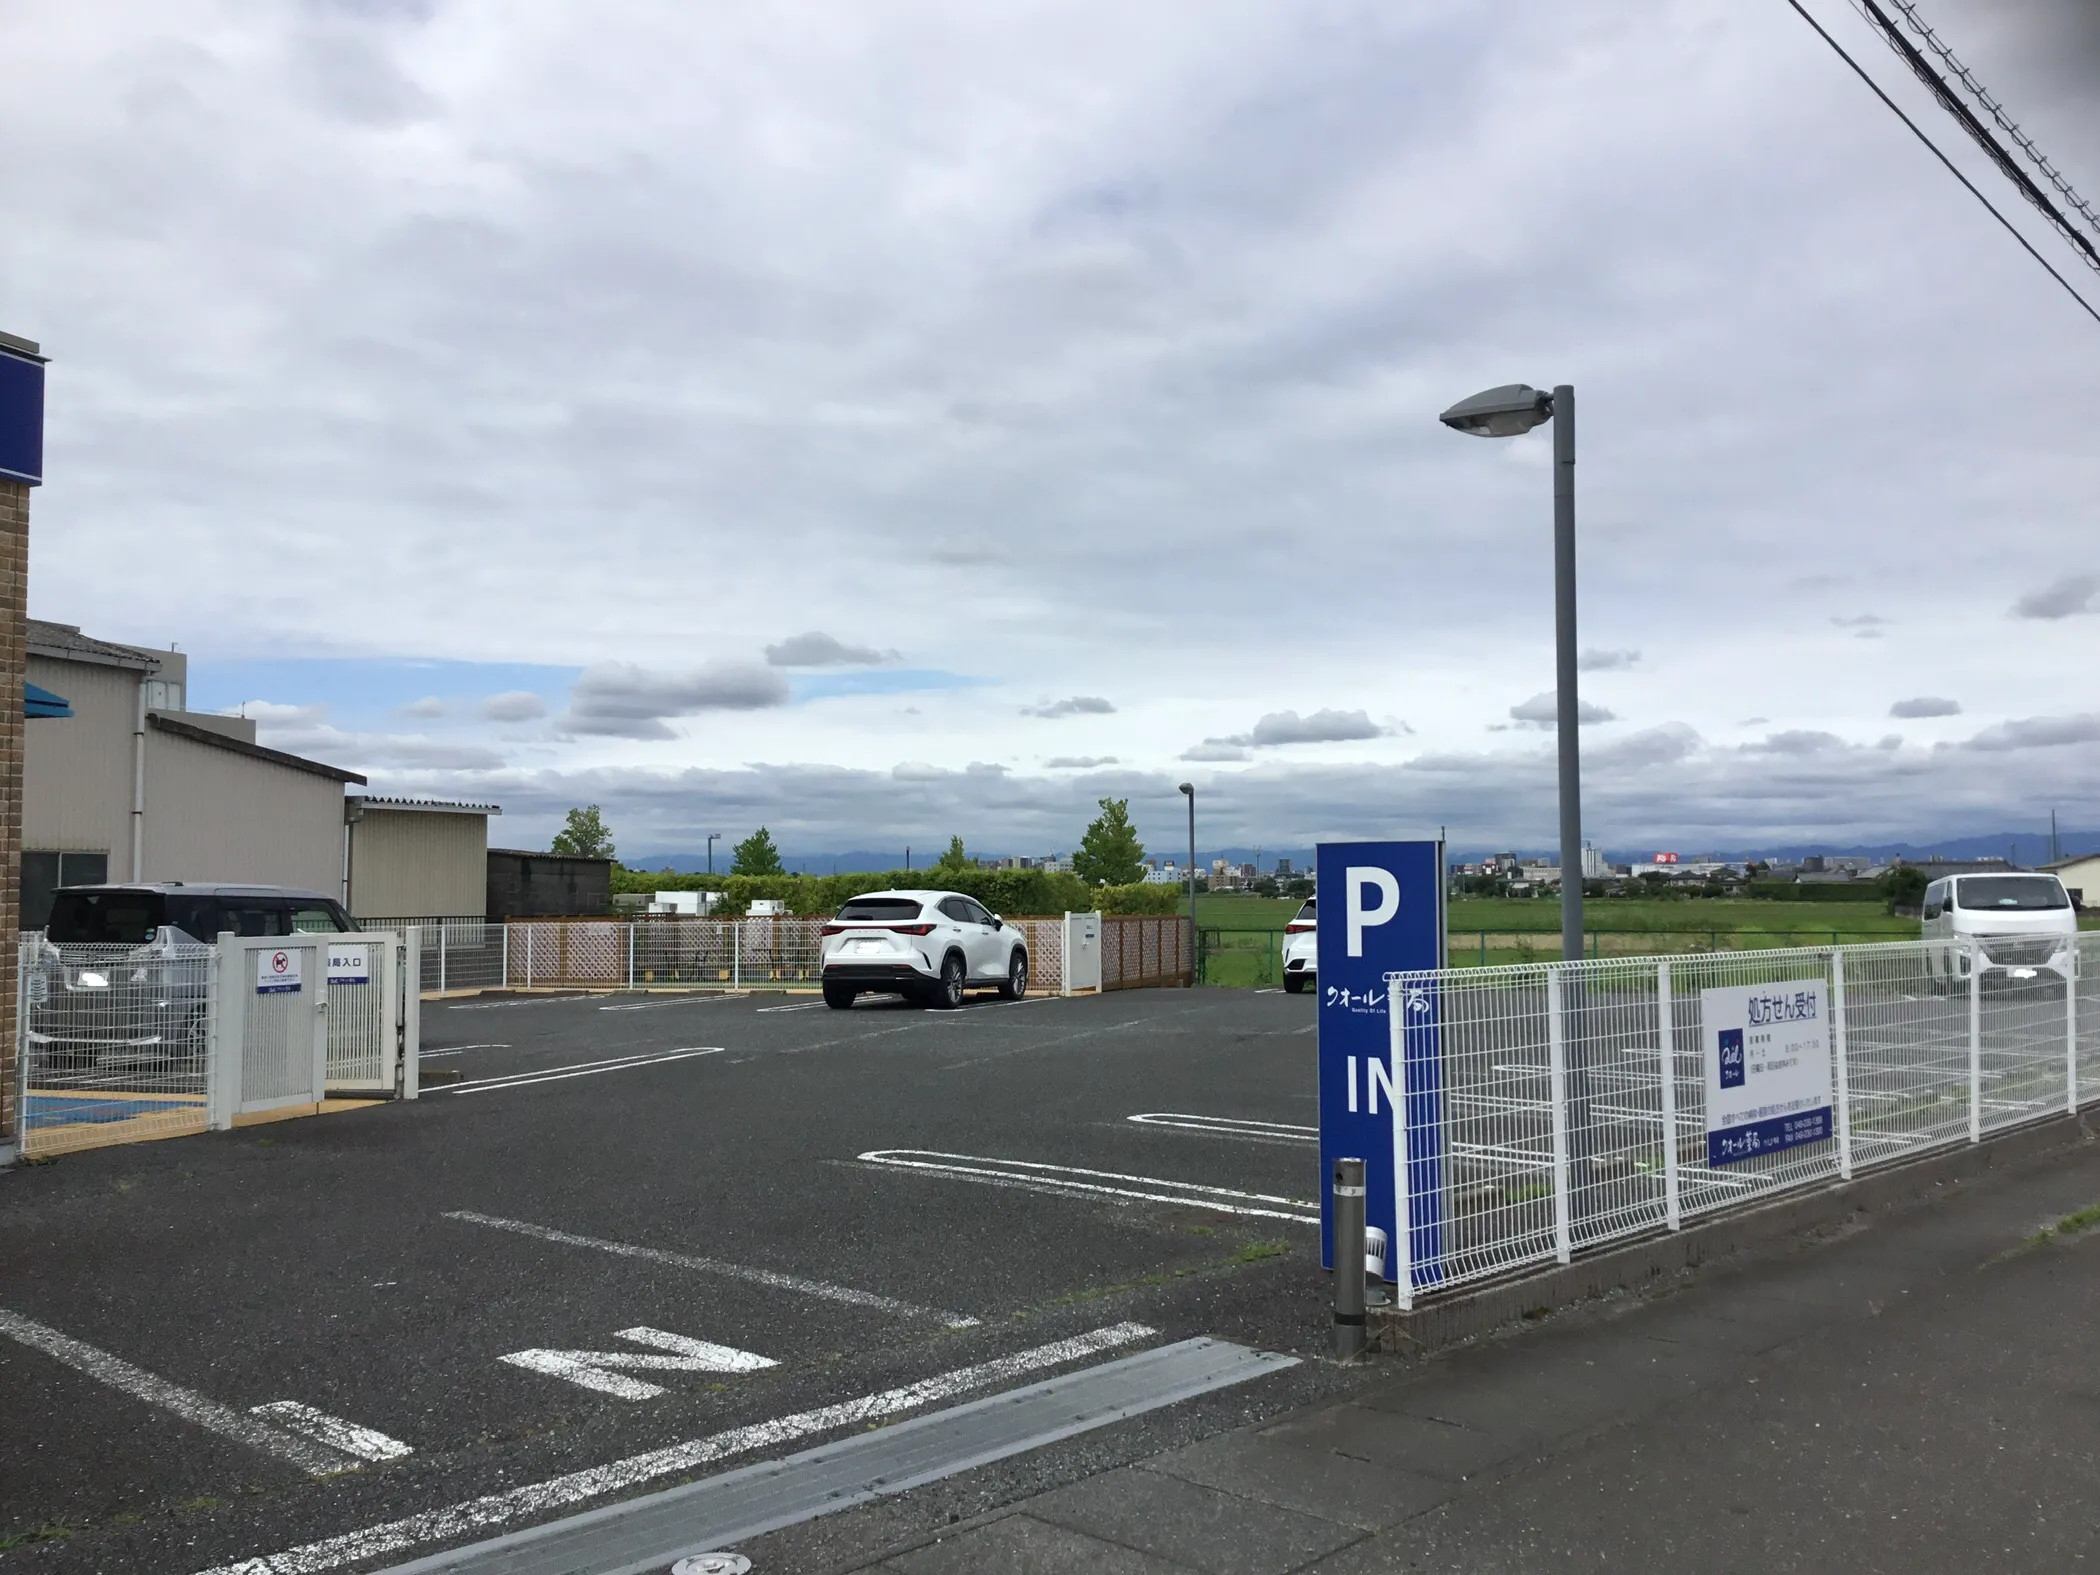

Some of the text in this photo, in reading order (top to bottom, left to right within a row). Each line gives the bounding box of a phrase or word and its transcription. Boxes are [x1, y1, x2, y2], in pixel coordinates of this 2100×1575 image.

[1346, 866, 1400, 957] P
[1327, 986, 1429, 1013] クオール局
[1749, 991, 1817, 1024] 処方せん受付
[1347, 1055, 1396, 1115] IN
